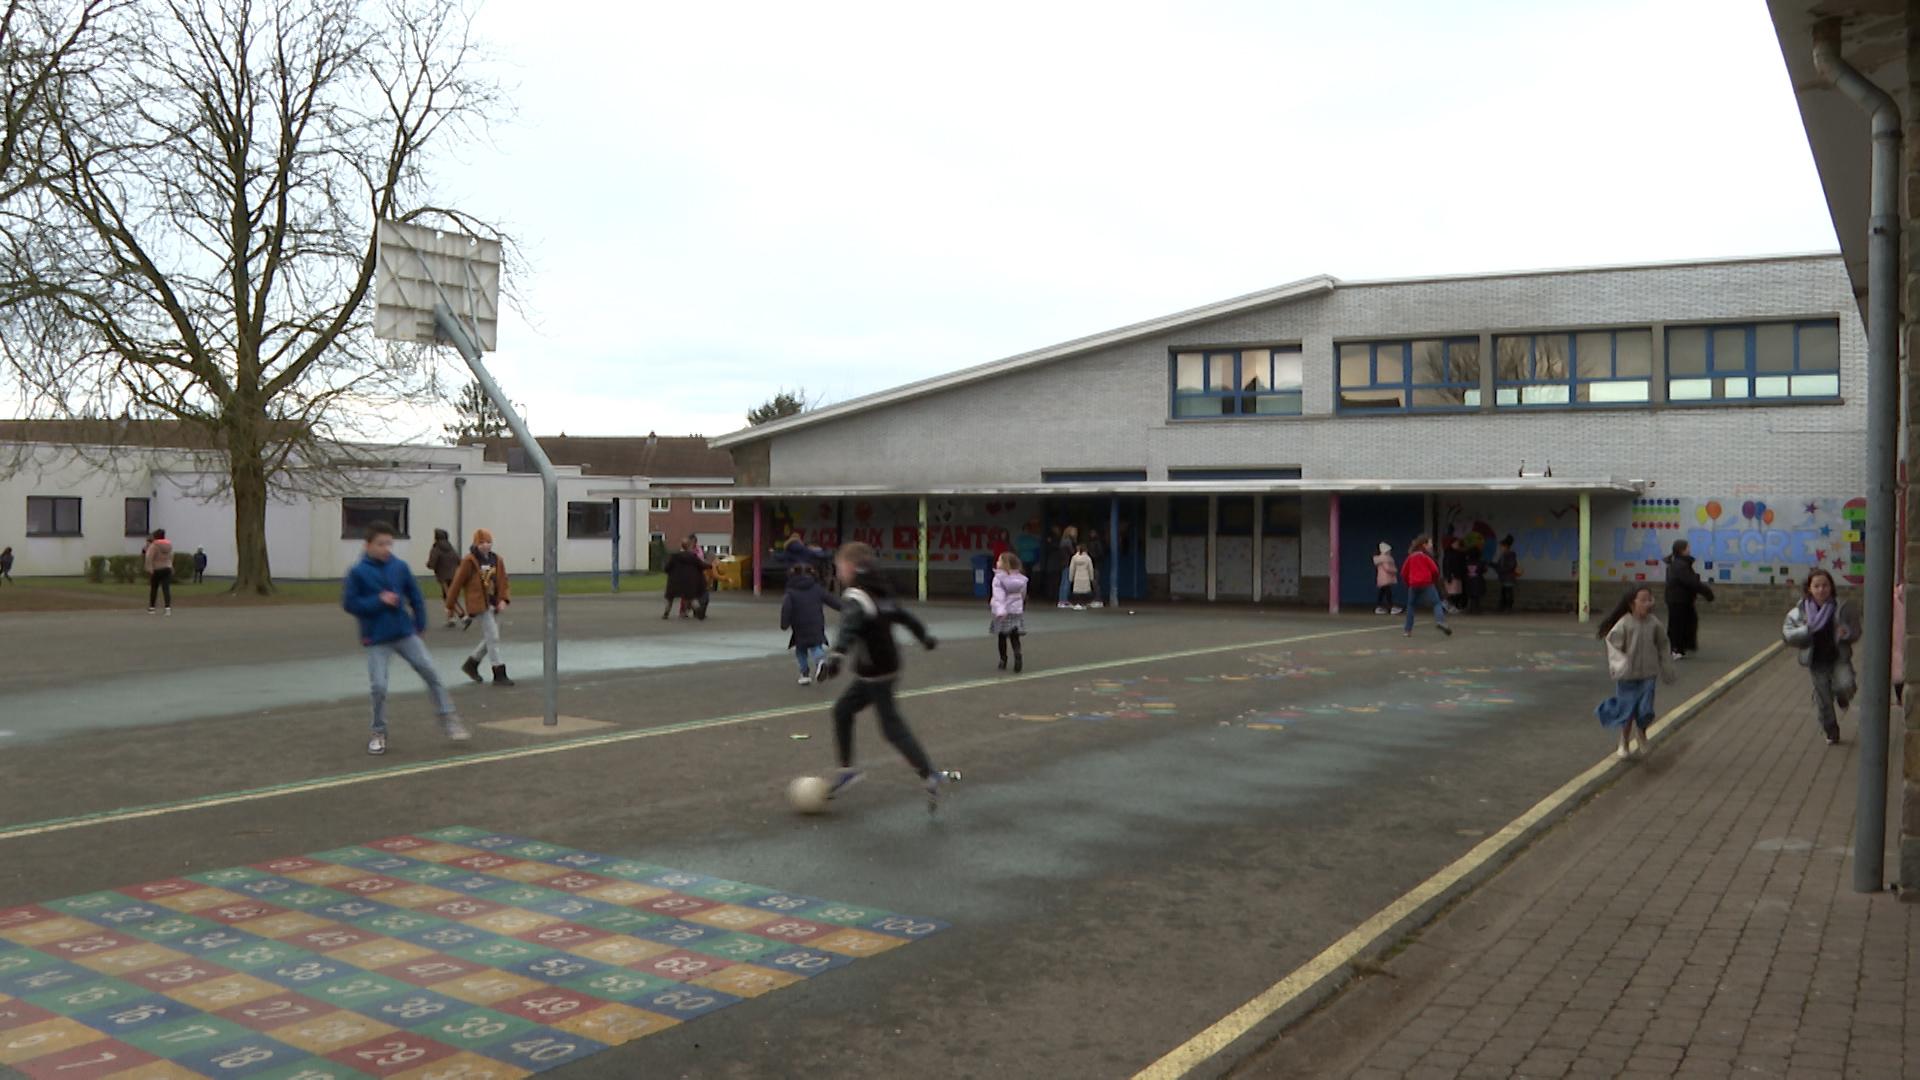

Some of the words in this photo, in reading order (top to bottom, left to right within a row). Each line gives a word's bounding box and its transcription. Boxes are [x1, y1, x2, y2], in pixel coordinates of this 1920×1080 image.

[1614, 527, 1662, 560] LA
[1688, 515, 1817, 563] RÉCRÉ
[759, 896, 807, 909] 98
[817, 907, 865, 921] 99
[141, 919, 195, 935] 33
[766, 922, 817, 937] 89
[873, 917, 936, 934] 100
[58, 937, 117, 953] 23
[306, 932, 358, 946] 45
[530, 958, 585, 976] 58
[654, 957, 707, 974] 69
[774, 952, 830, 968] 80
[146, 965, 207, 983] 25
[276, 962, 336, 981] 36
[407, 962, 463, 977] 47
[327, 979, 390, 997] 37
[382, 997, 445, 1018] 38
[522, 996, 580, 1015] 49
[653, 990, 715, 1010] 60
[108, 1005, 166, 1024] 16
[243, 1001, 310, 1020] 27
[157, 1024, 219, 1042] 17
[442, 1016, 507, 1038] 39
[210, 1046, 274, 1069] 18
[356, 1042, 426, 1066] 29
[510, 1038, 576, 1061] 40
[56, 1052, 117, 1070] 7
